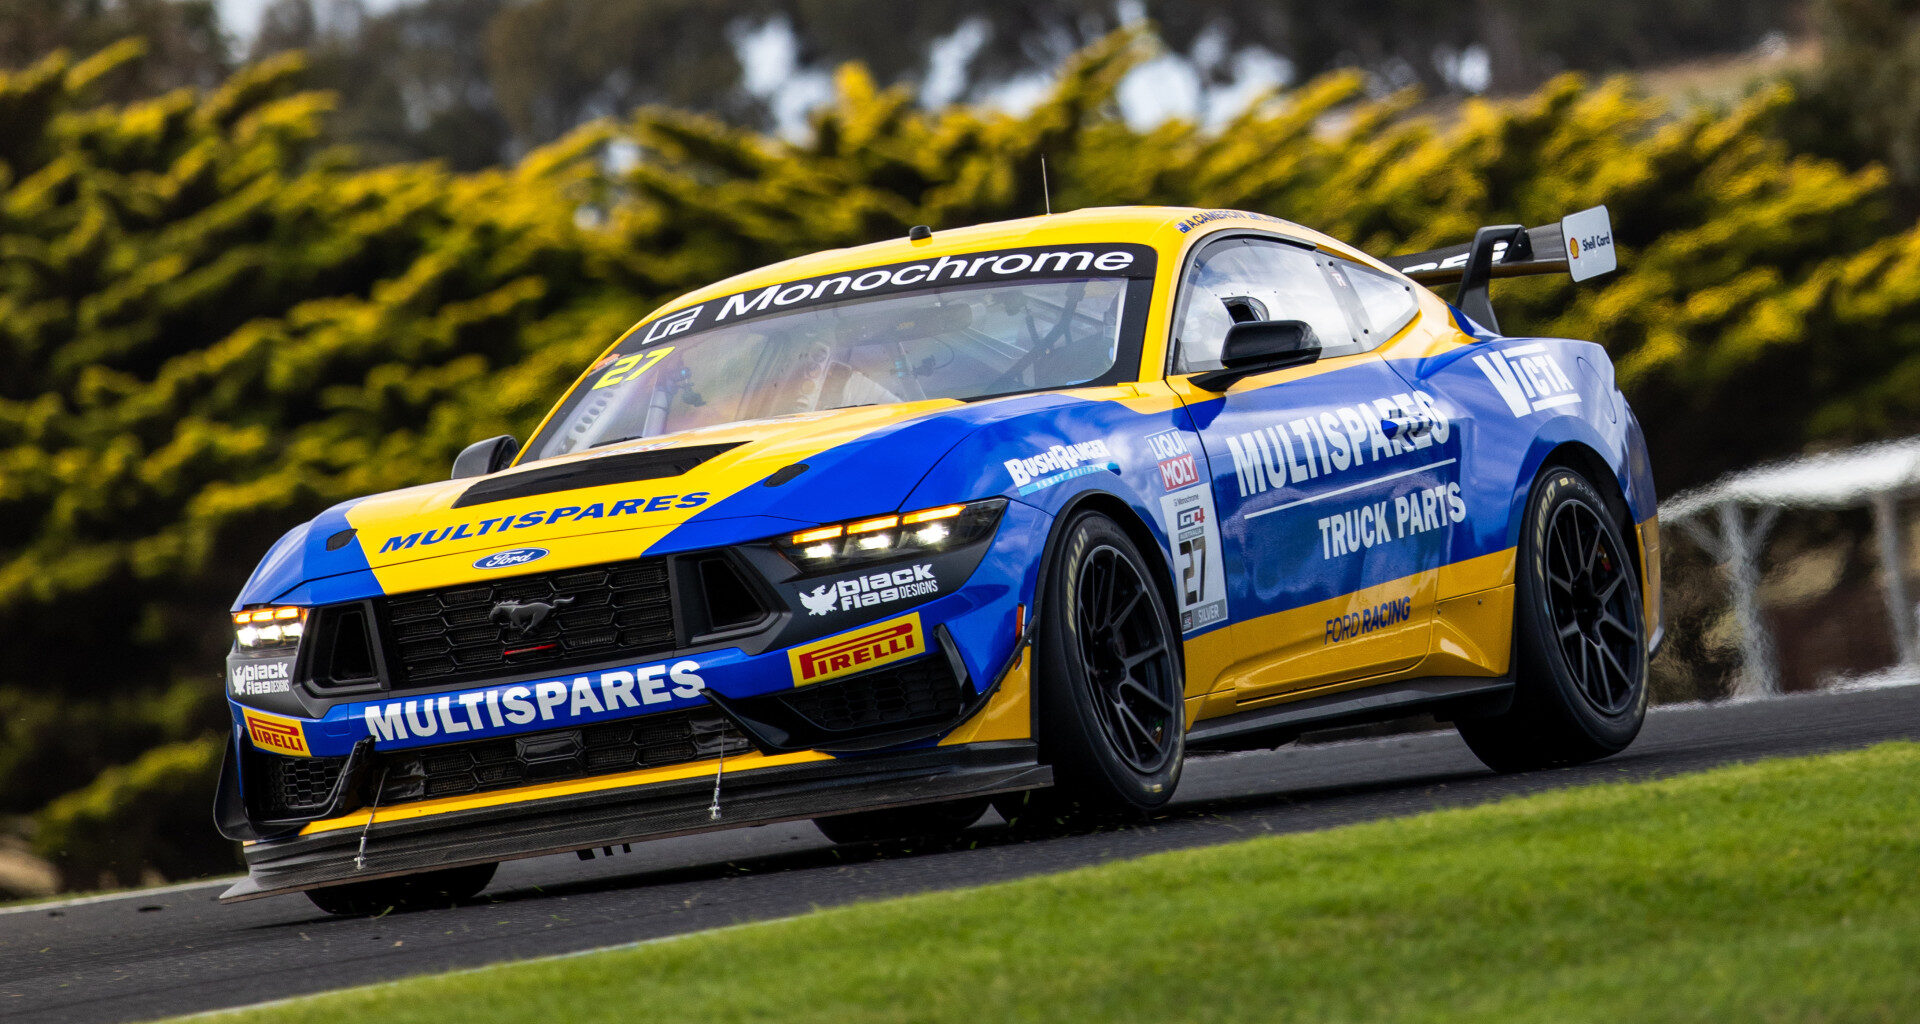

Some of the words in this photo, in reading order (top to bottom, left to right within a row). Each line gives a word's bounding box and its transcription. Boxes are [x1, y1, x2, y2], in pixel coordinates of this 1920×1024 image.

[1582, 236, 1596, 251] Shell
[1597, 231, 1610, 247] Card
[715, 250, 1134, 321] Monochrome
[592, 346, 675, 390] 27
[1148, 431, 1187, 460] LIQUI
[1226, 390, 1450, 497] MULTISPARES
[1160, 456, 1195, 487] MOLY
[379, 491, 711, 553] MULTISPARES
[1318, 501, 1391, 560] TRUCK
[1395, 482, 1466, 539] PARTS
[486, 550, 535, 567] Ford
[1179, 537, 1206, 606] 27
[837, 564, 935, 597] black
[841, 587, 899, 611] flag
[899, 580, 939, 599] DESIGNS
[1198, 604, 1220, 622] SILVER
[1324, 612, 1360, 645] FORD
[1362, 596, 1411, 634] RACING
[799, 623, 915, 680] PIRELLI
[245, 662, 288, 680] black
[246, 681, 271, 695] flag
[364, 660, 706, 742] MULTISPARES
[247, 716, 303, 751] PIRELLI
